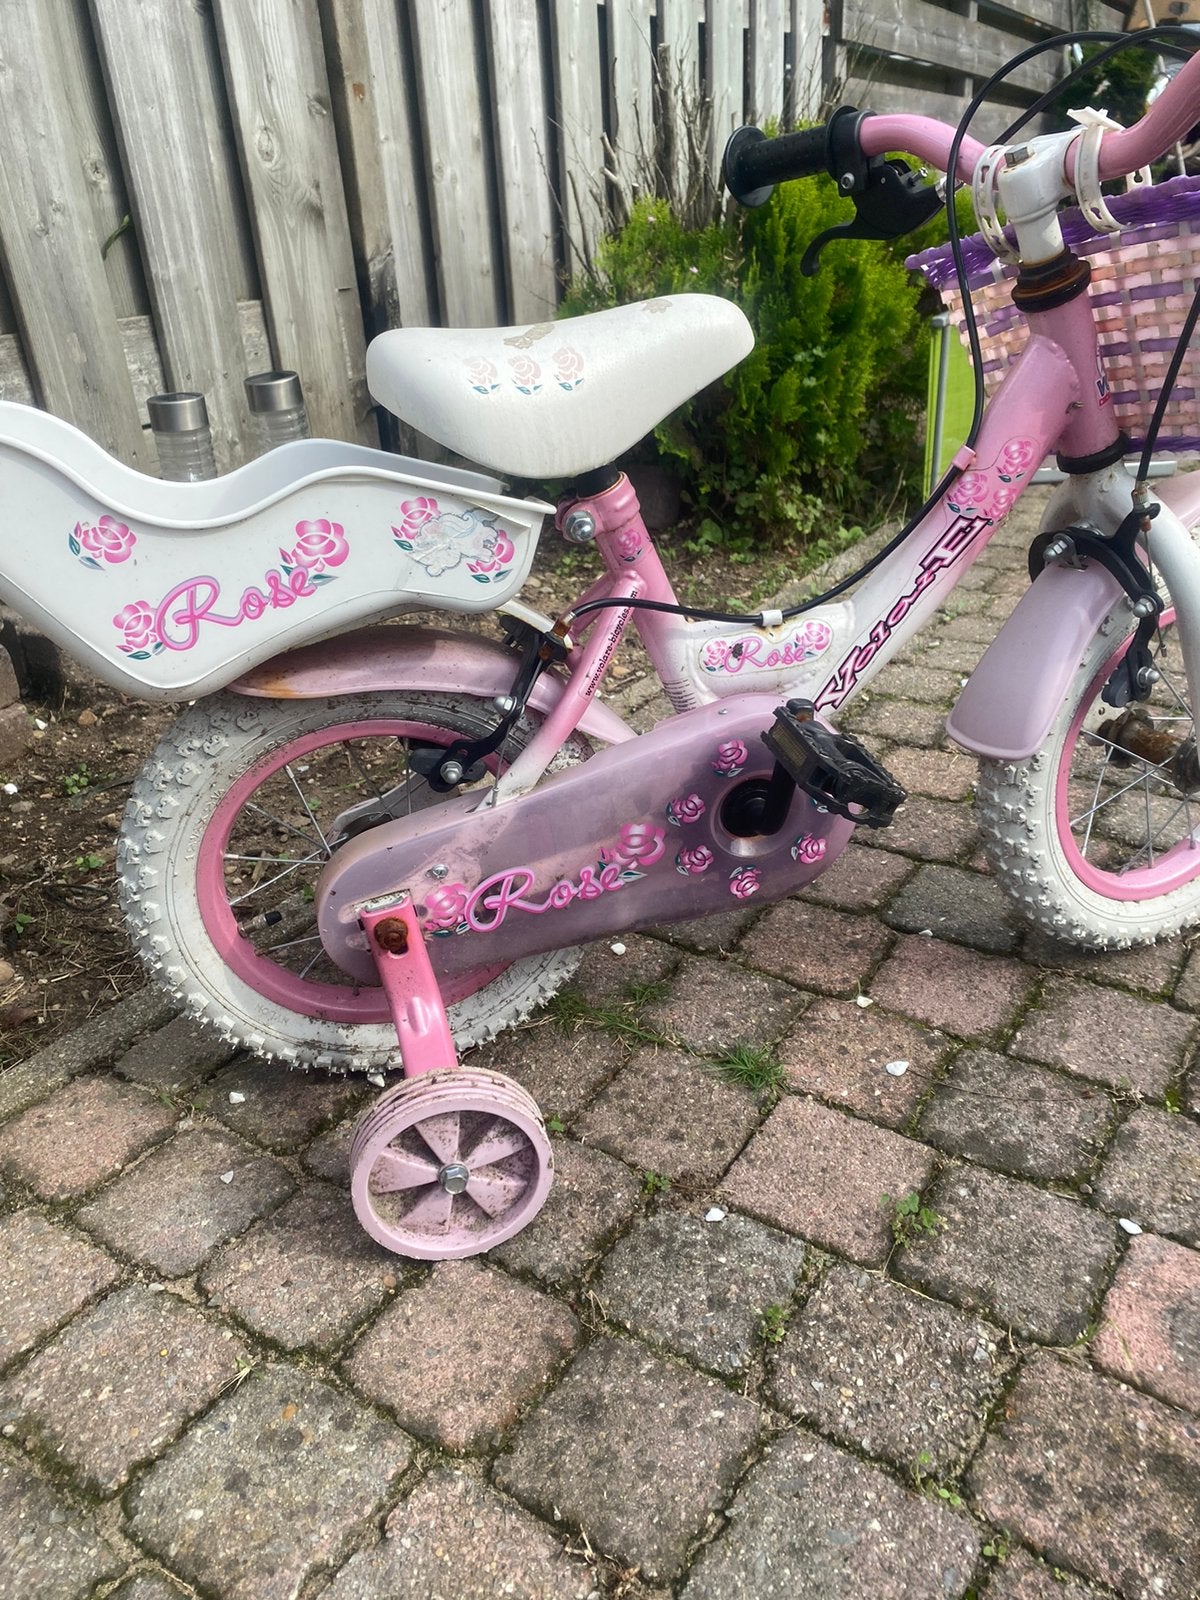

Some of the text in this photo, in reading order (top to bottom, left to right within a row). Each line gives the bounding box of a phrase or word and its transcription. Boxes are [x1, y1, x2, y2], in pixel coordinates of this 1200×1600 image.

[156, 564, 316, 652] Rose
[585, 590, 638, 696] www.volare-bicycles.m
[724, 634, 806, 673] Rose
[464, 864, 626, 932] Rose
